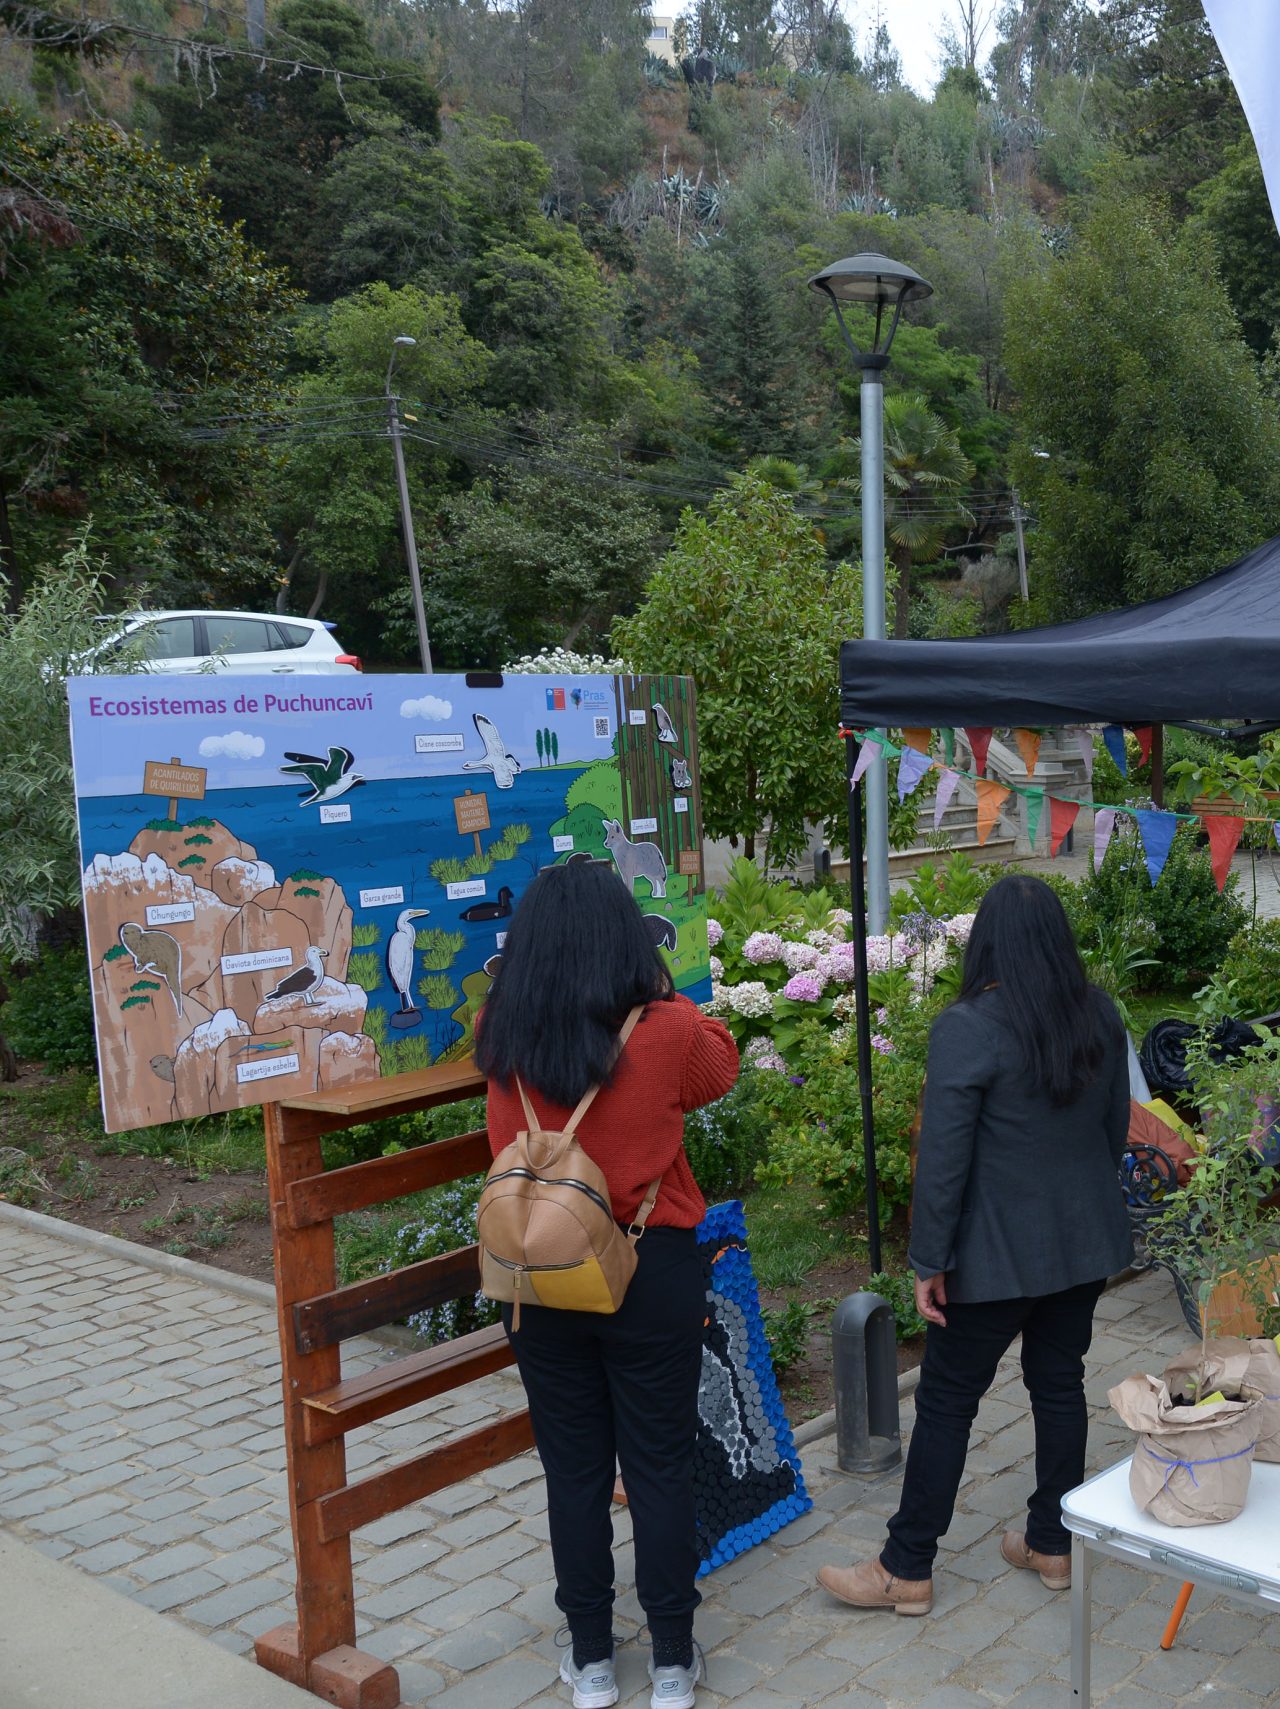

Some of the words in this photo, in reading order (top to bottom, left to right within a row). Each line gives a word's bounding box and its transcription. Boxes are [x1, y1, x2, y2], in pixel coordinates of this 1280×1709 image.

[89, 696, 227, 717] Ecosistemas
[234, 695, 258, 713] de
[265, 693, 373, 713] Puchuncaví
[153, 768, 200, 782] ACANTILADOS
[150, 779, 160, 789] DE
[324, 808, 348, 819] Piquero
[363, 892, 380, 903] Garza
[381, 889, 402, 902] grande
[450, 885, 466, 896] Tagua
[151, 908, 192, 921] Chungungo
[225, 958, 251, 970] Gaviota
[253, 954, 290, 966] dominicana
[242, 1066, 271, 1079] Lagartija
[273, 1061, 297, 1072] esbelta
